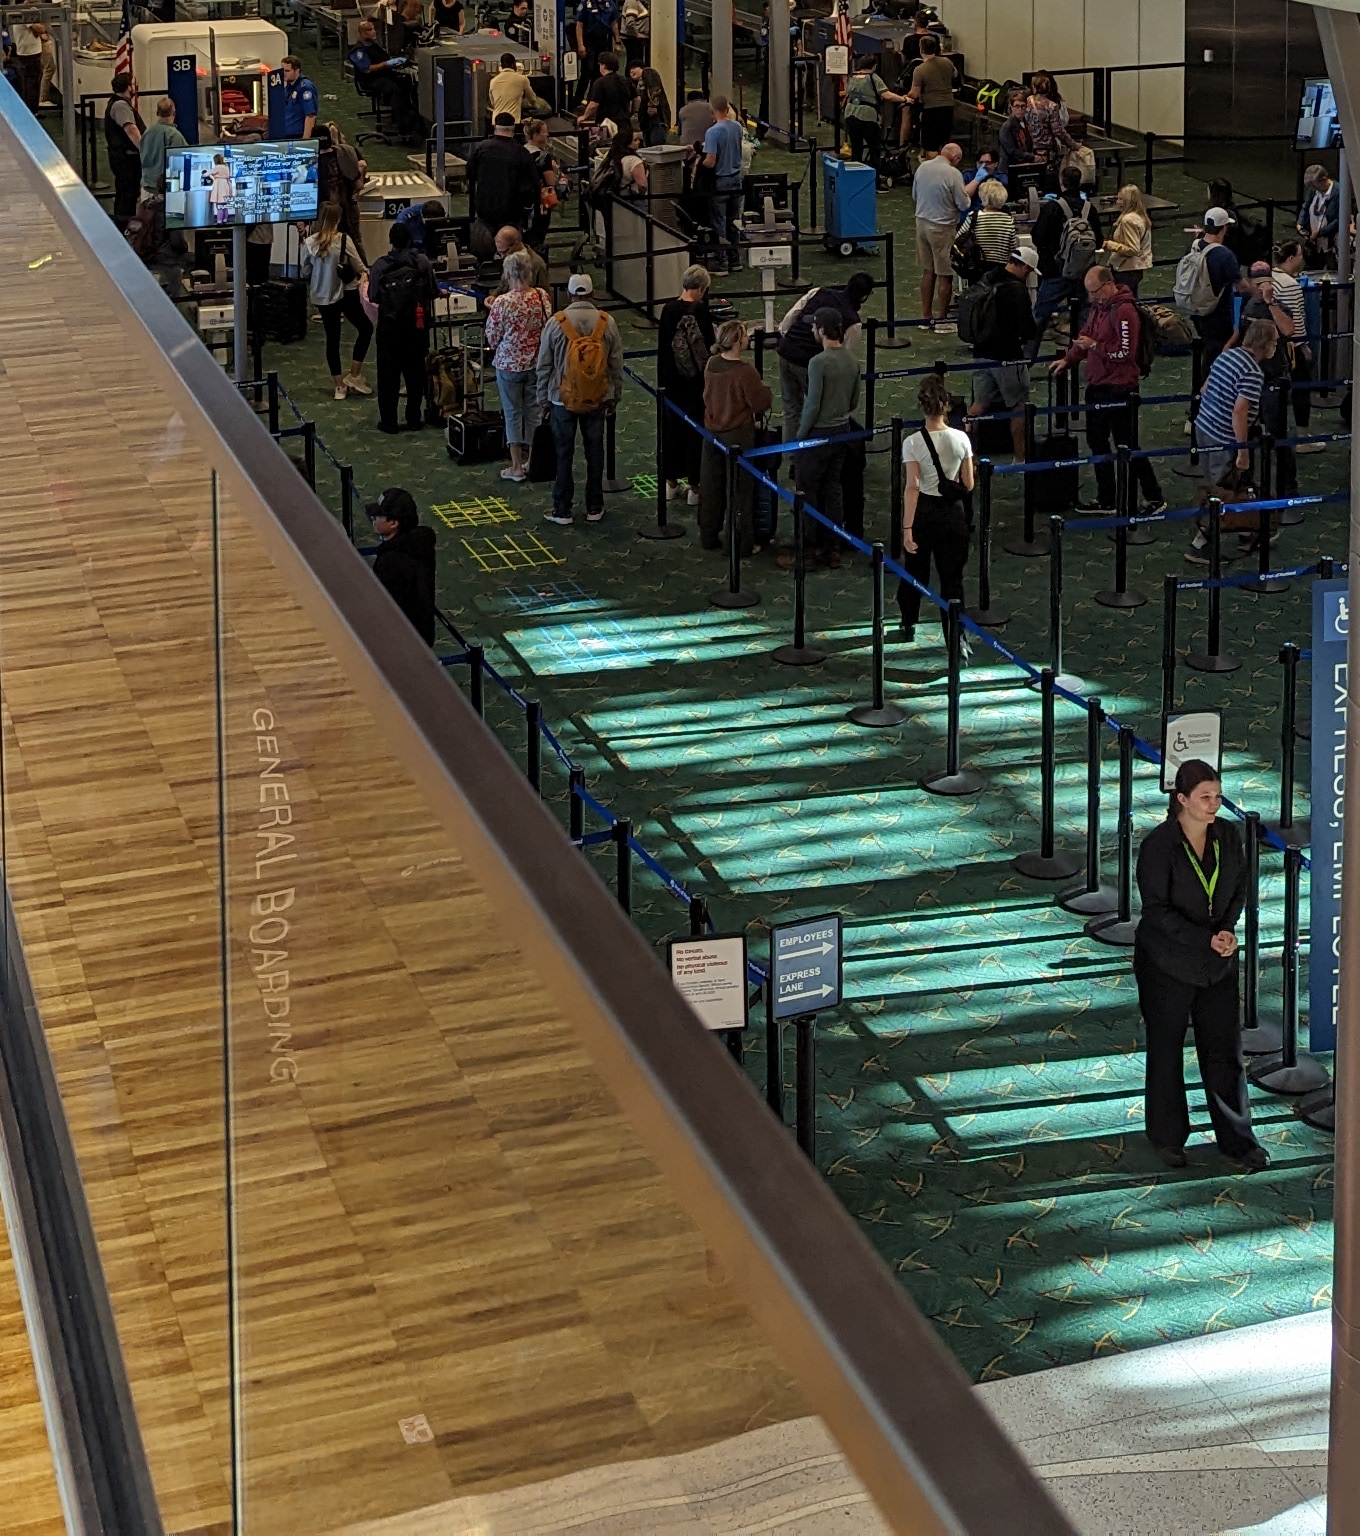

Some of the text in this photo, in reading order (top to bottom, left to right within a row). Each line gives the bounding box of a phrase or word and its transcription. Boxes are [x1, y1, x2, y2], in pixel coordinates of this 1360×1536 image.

[173, 59, 191, 71] 3B
[270, 72, 282, 87] 3A
[248, 706, 299, 1084] GENERAL BOARDING
[779, 928, 834, 948] EMPLOYEES
[779, 966, 821, 984] EXPRESS
[779, 981, 804, 994] LANE
